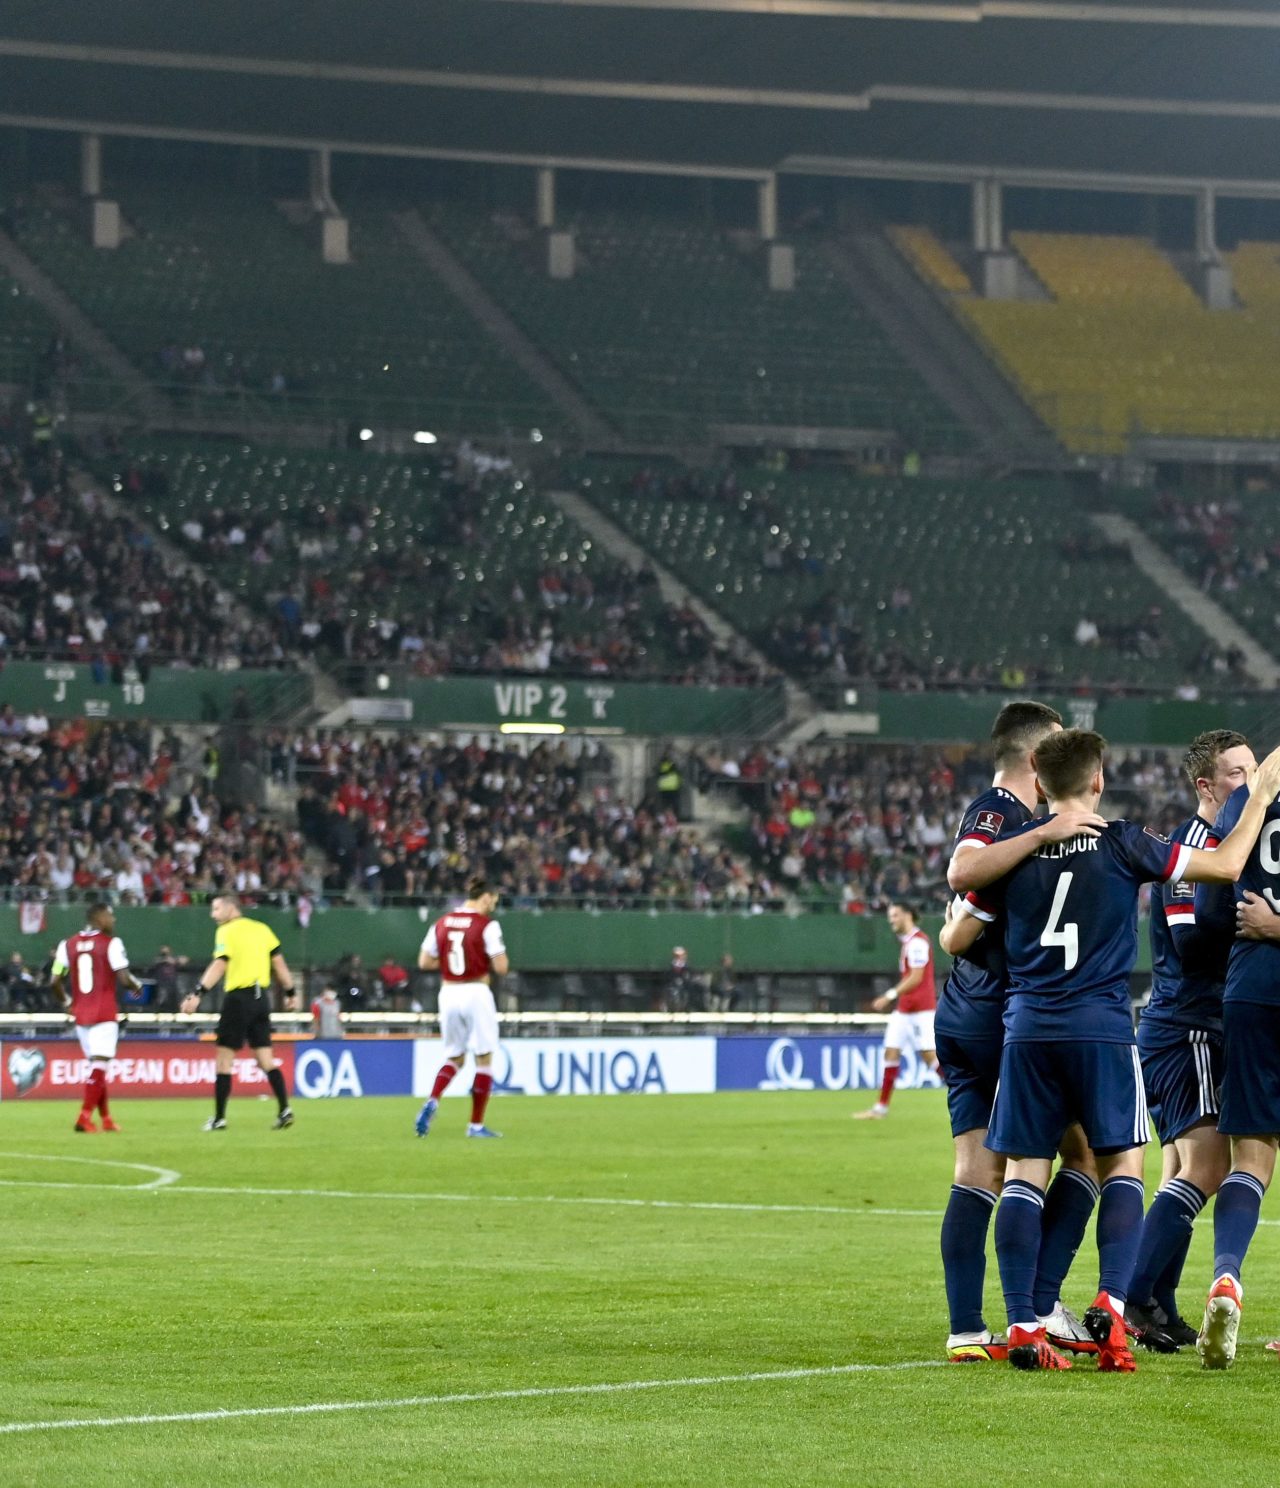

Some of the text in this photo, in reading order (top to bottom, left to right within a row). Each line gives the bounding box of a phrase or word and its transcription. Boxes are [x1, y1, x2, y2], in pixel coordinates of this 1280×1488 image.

[54, 681, 66, 701] J
[122, 683, 145, 704] 19
[494, 683, 543, 717] VIP
[549, 684, 568, 718] 2
[1040, 871, 1079, 971] 4
[447, 930, 466, 976] 3
[51, 1058, 164, 1084] EURPEAN
[295, 1049, 363, 1098] QA
[538, 1051, 667, 1093] UNIQA
